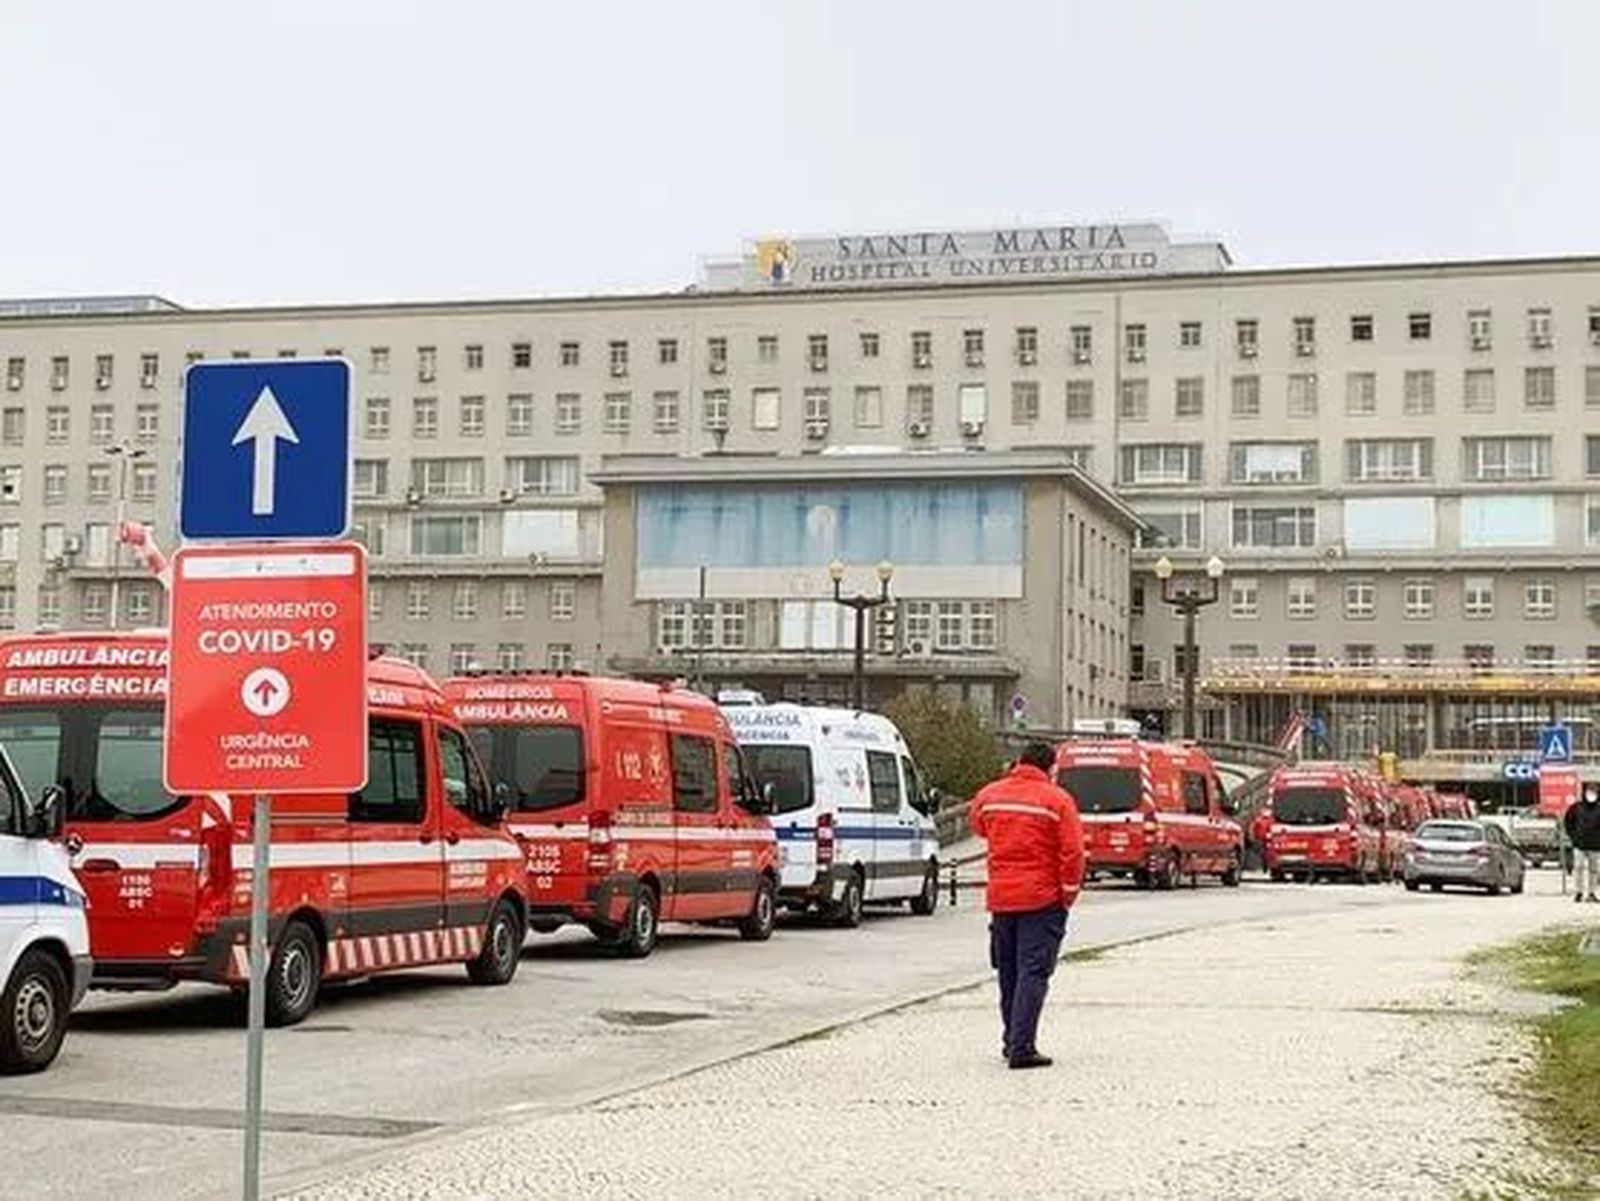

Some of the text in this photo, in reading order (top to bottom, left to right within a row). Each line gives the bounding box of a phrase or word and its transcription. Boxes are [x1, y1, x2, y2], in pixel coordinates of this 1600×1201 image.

[838, 225, 1127, 259] SANTA MARIA
[811, 261, 931, 282] HOSPITAL
[198, 602, 337, 621] ATENDIMENTO
[198, 628, 336, 653] COVID-19
[6, 646, 169, 668] AMBULÂNCIA
[4, 673, 167, 697] EMERGÊNCIA
[220, 731, 309, 749] URGÊNCIA
[225, 754, 303, 771] CENTRAL
